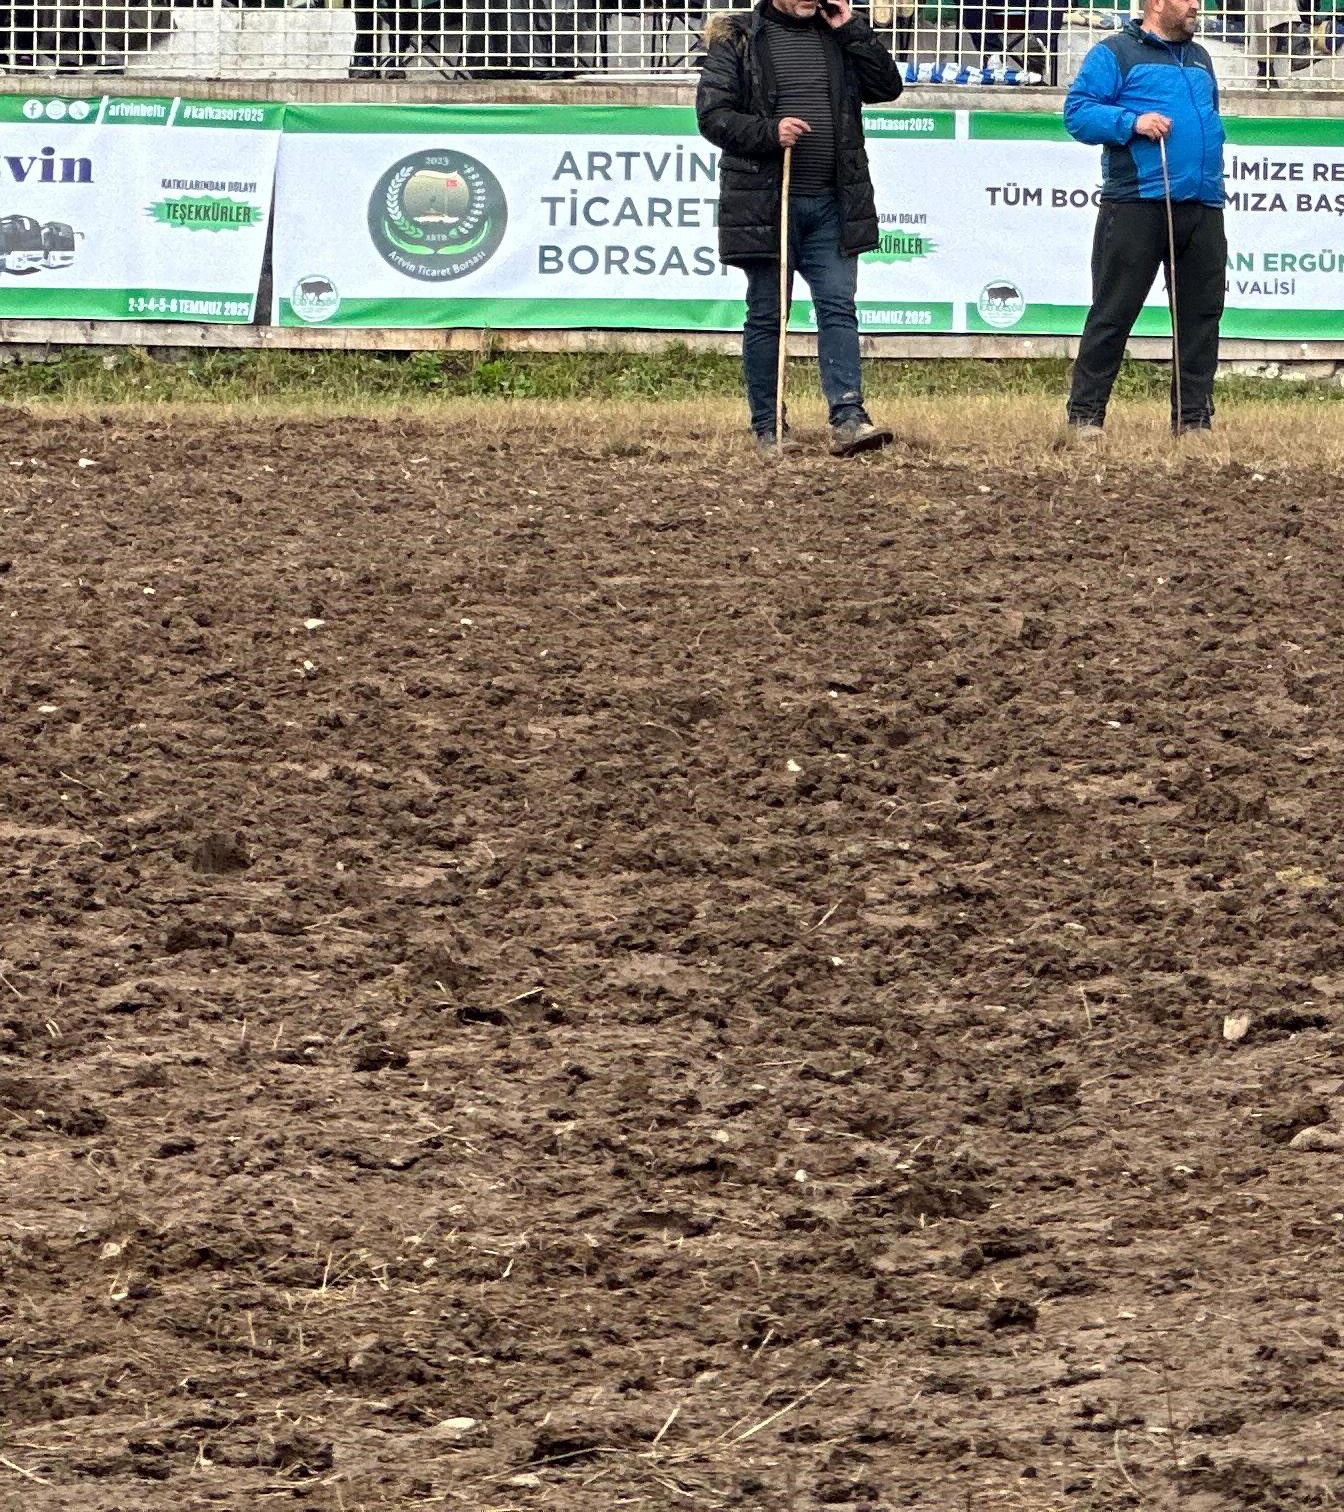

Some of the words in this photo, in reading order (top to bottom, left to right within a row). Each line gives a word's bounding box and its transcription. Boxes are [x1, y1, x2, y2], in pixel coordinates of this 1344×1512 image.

[863, 117, 935, 131] kafkasor2025
[0, 146, 94, 184] vin
[552, 144, 717, 182] ARTVİN
[986, 182, 1042, 207] TÜM
[166, 201, 252, 225] TEŞEKKÜRLER
[541, 188, 718, 228] TİCARET
[1236, 278, 1296, 296] VALİSİ
[178, 299, 223, 315] TEMMUZ
[223, 300, 249, 316] 2025
